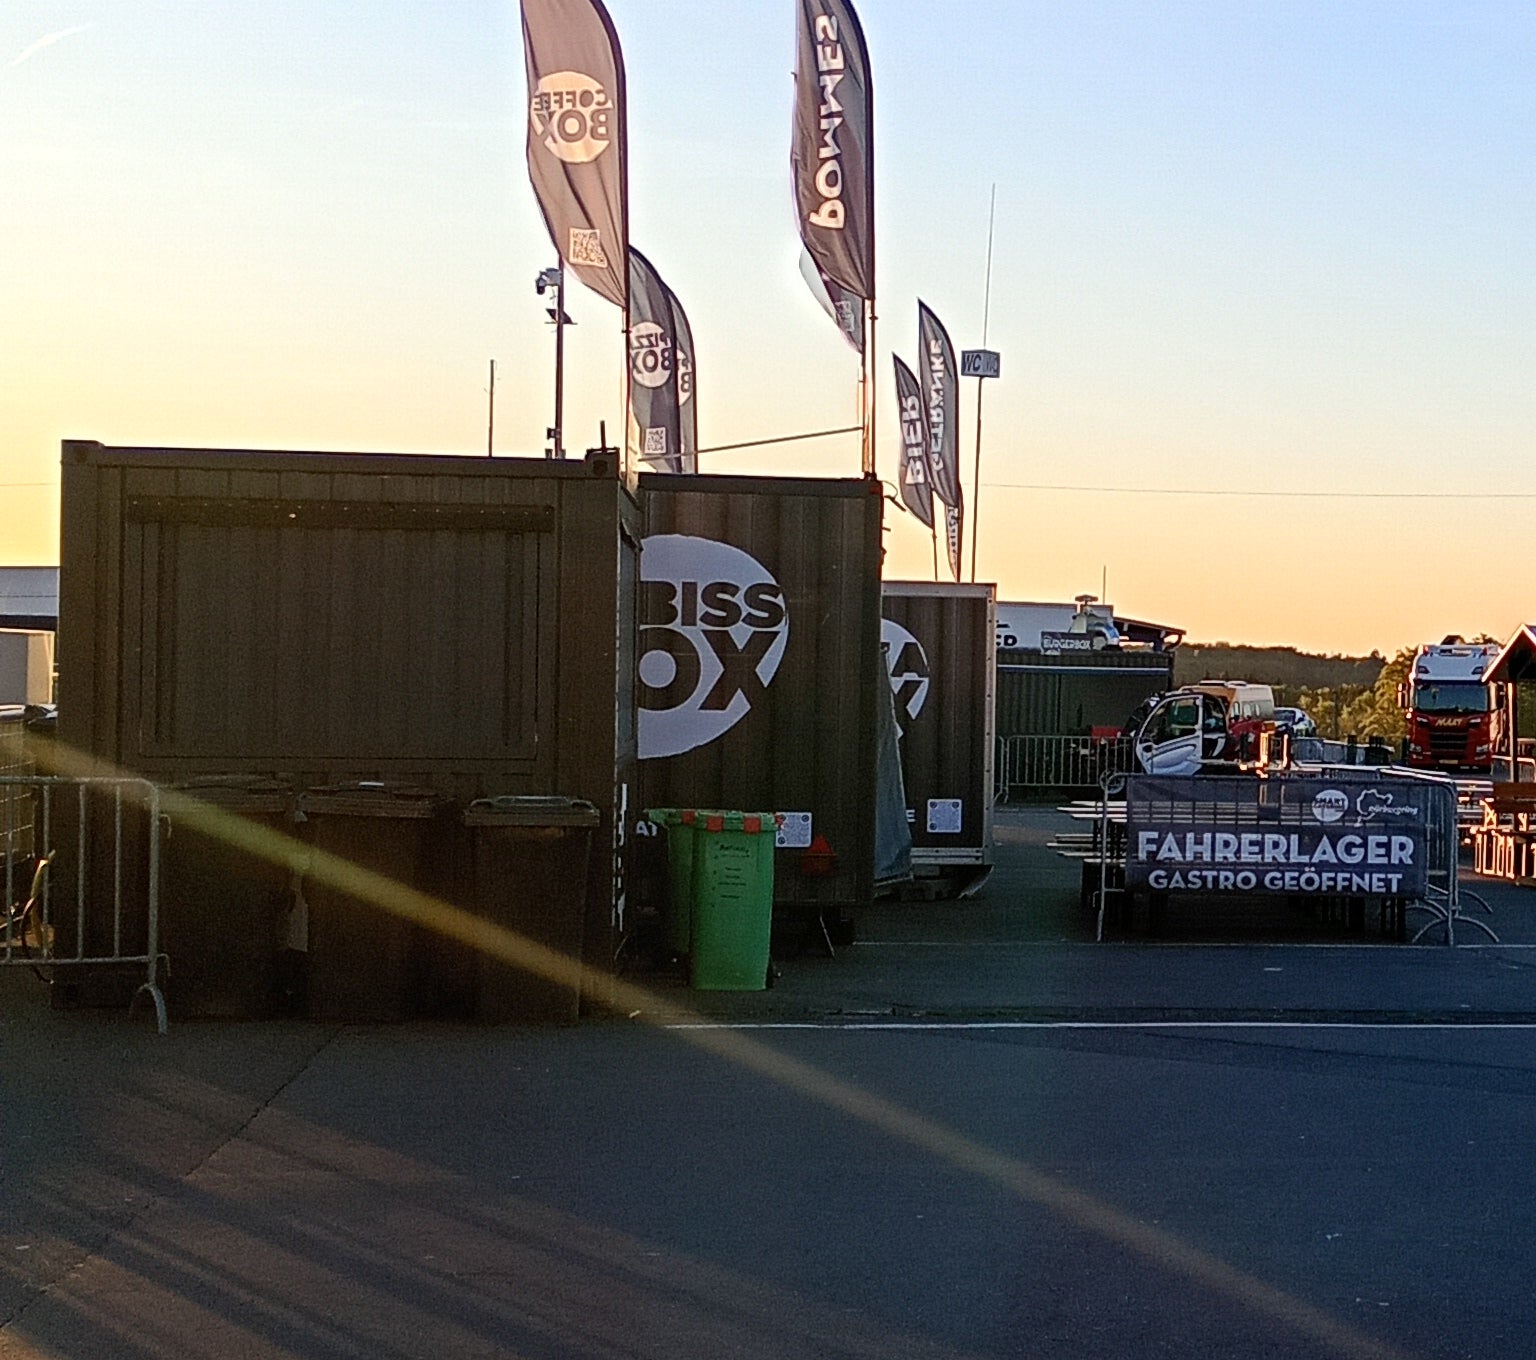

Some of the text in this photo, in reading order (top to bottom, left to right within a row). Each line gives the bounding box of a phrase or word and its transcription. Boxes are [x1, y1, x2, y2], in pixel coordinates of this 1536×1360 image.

[965, 353, 982, 372] WC
[640, 581, 786, 629] BISS
[638, 627, 781, 712] OX
[1137, 831, 1415, 865] FAHRERLAGER
[1149, 866, 1403, 893] GASTRO GEÖFFNET
